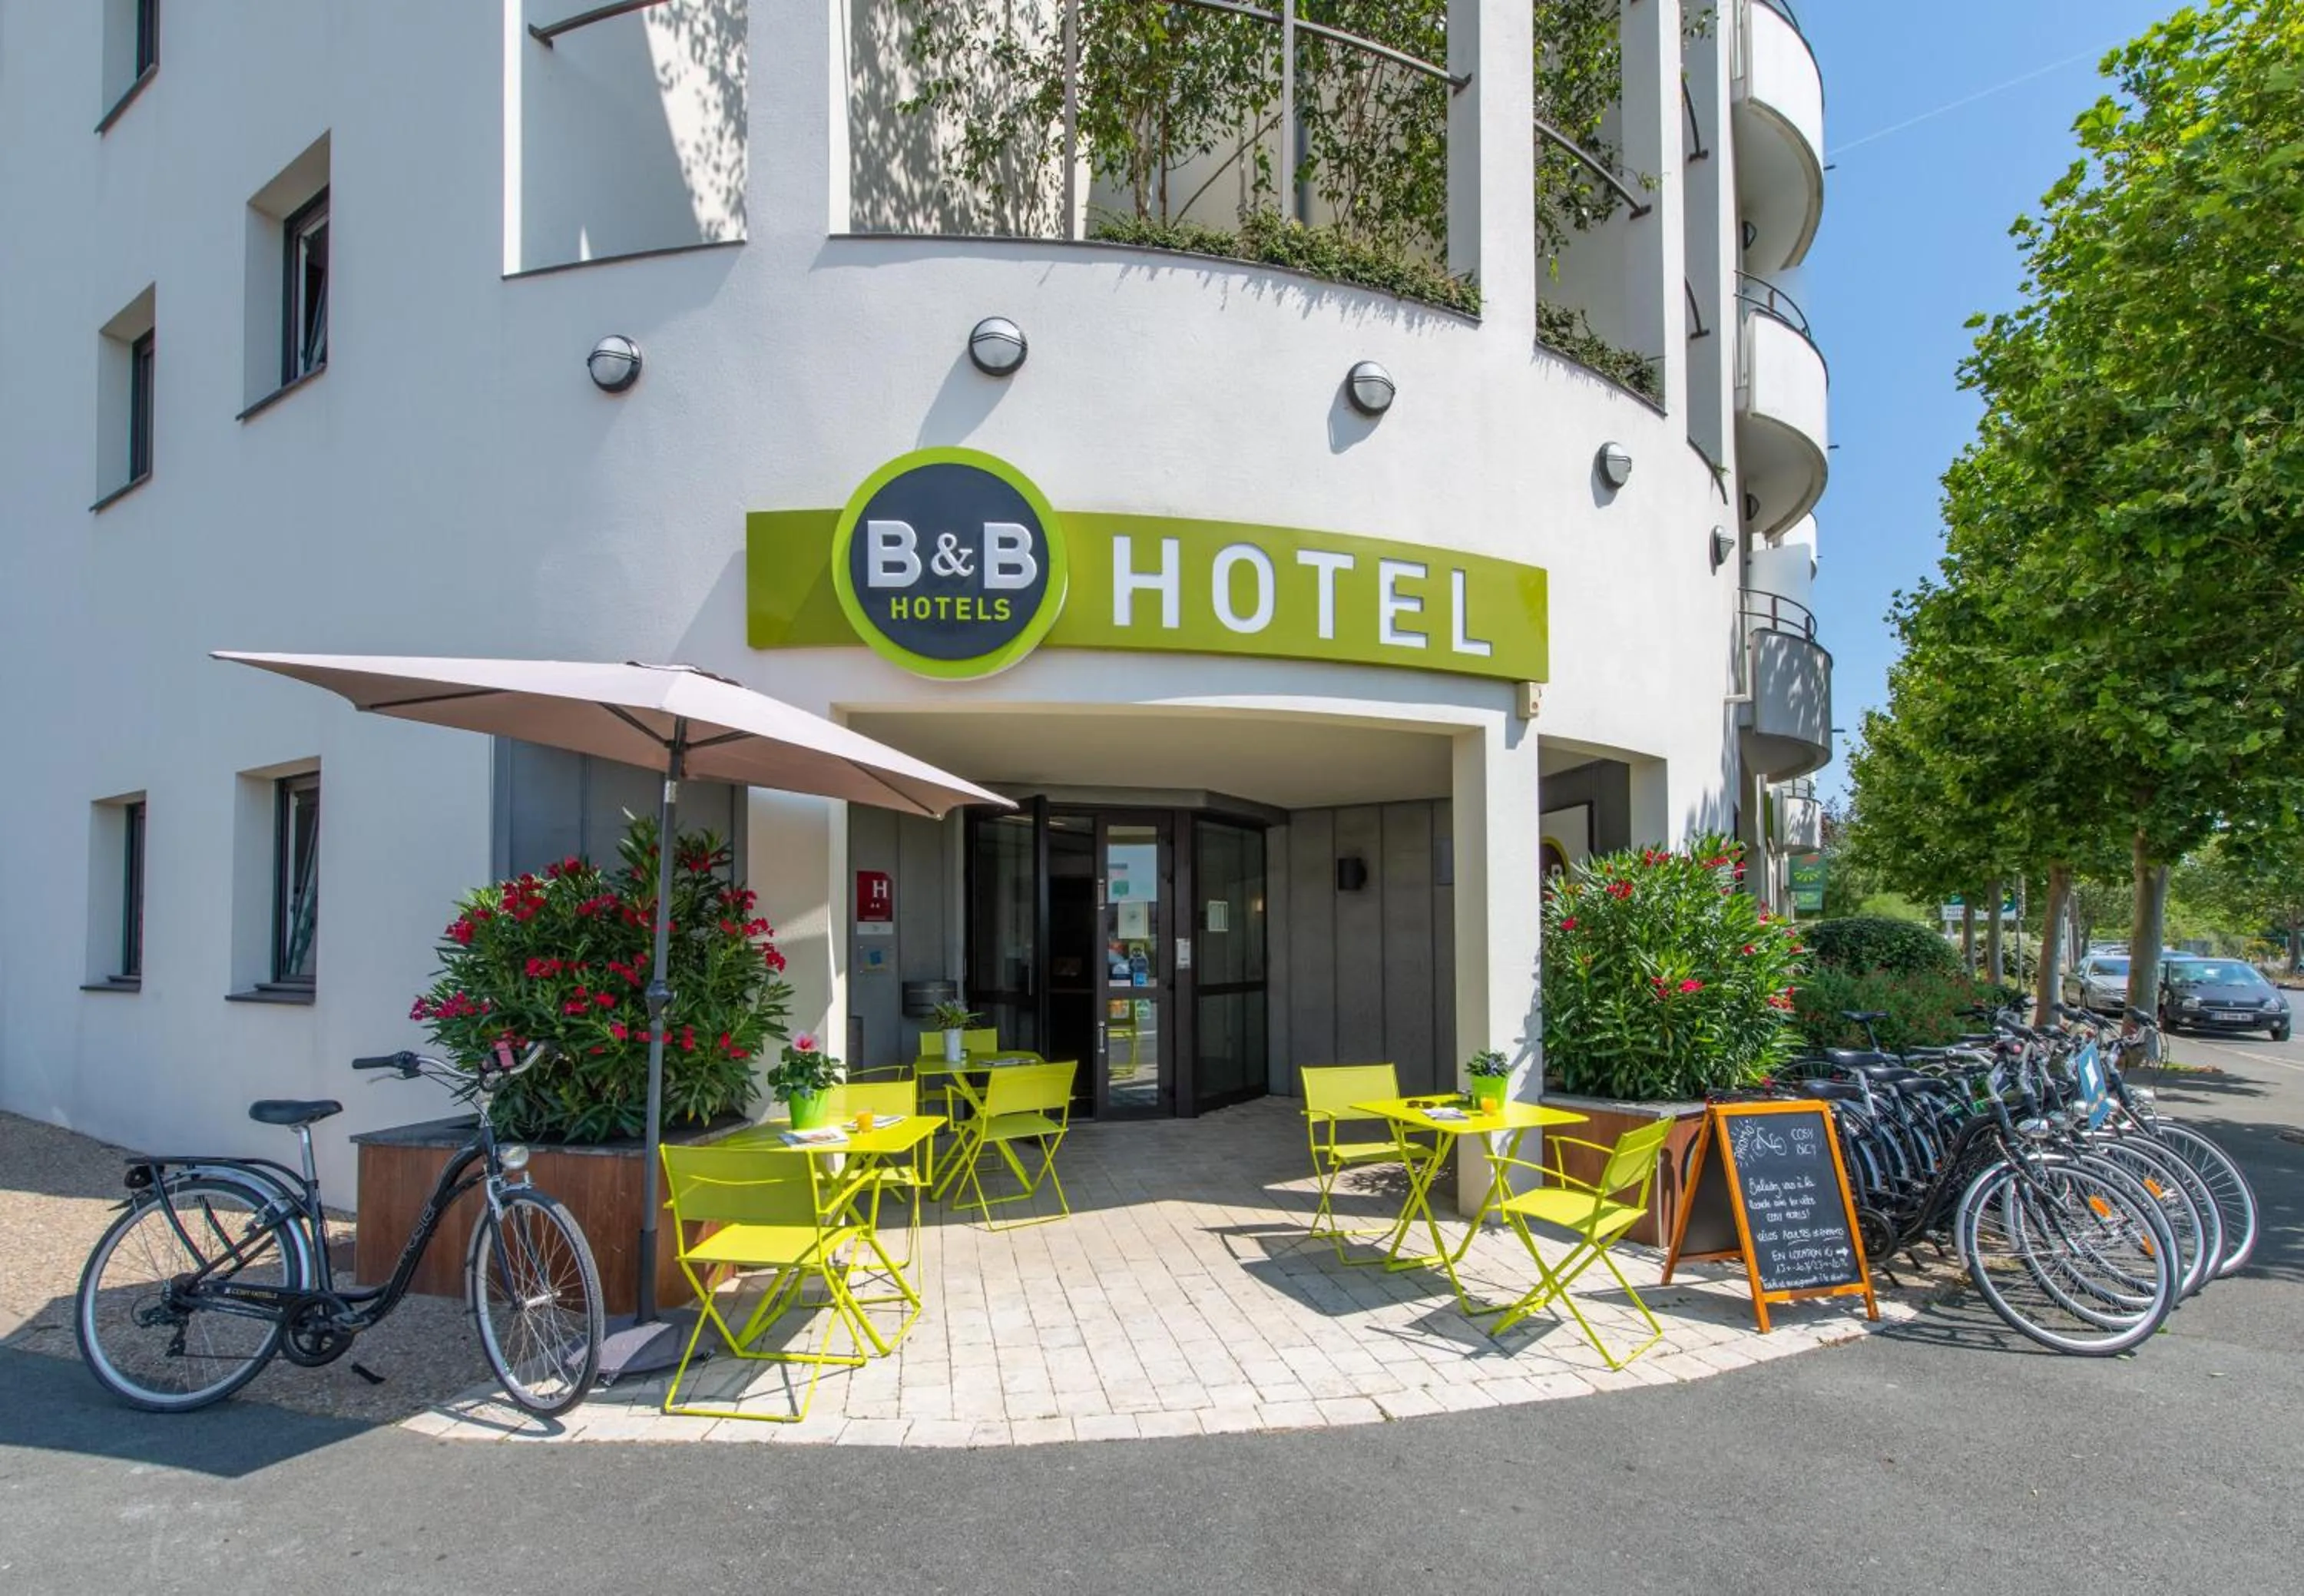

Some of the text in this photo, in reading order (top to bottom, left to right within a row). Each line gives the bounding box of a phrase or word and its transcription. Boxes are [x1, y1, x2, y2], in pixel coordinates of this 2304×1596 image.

[890, 596, 1011, 621] HOTELS
[1112, 535, 1493, 657] HOTEL
[872, 879, 889, 899] H
